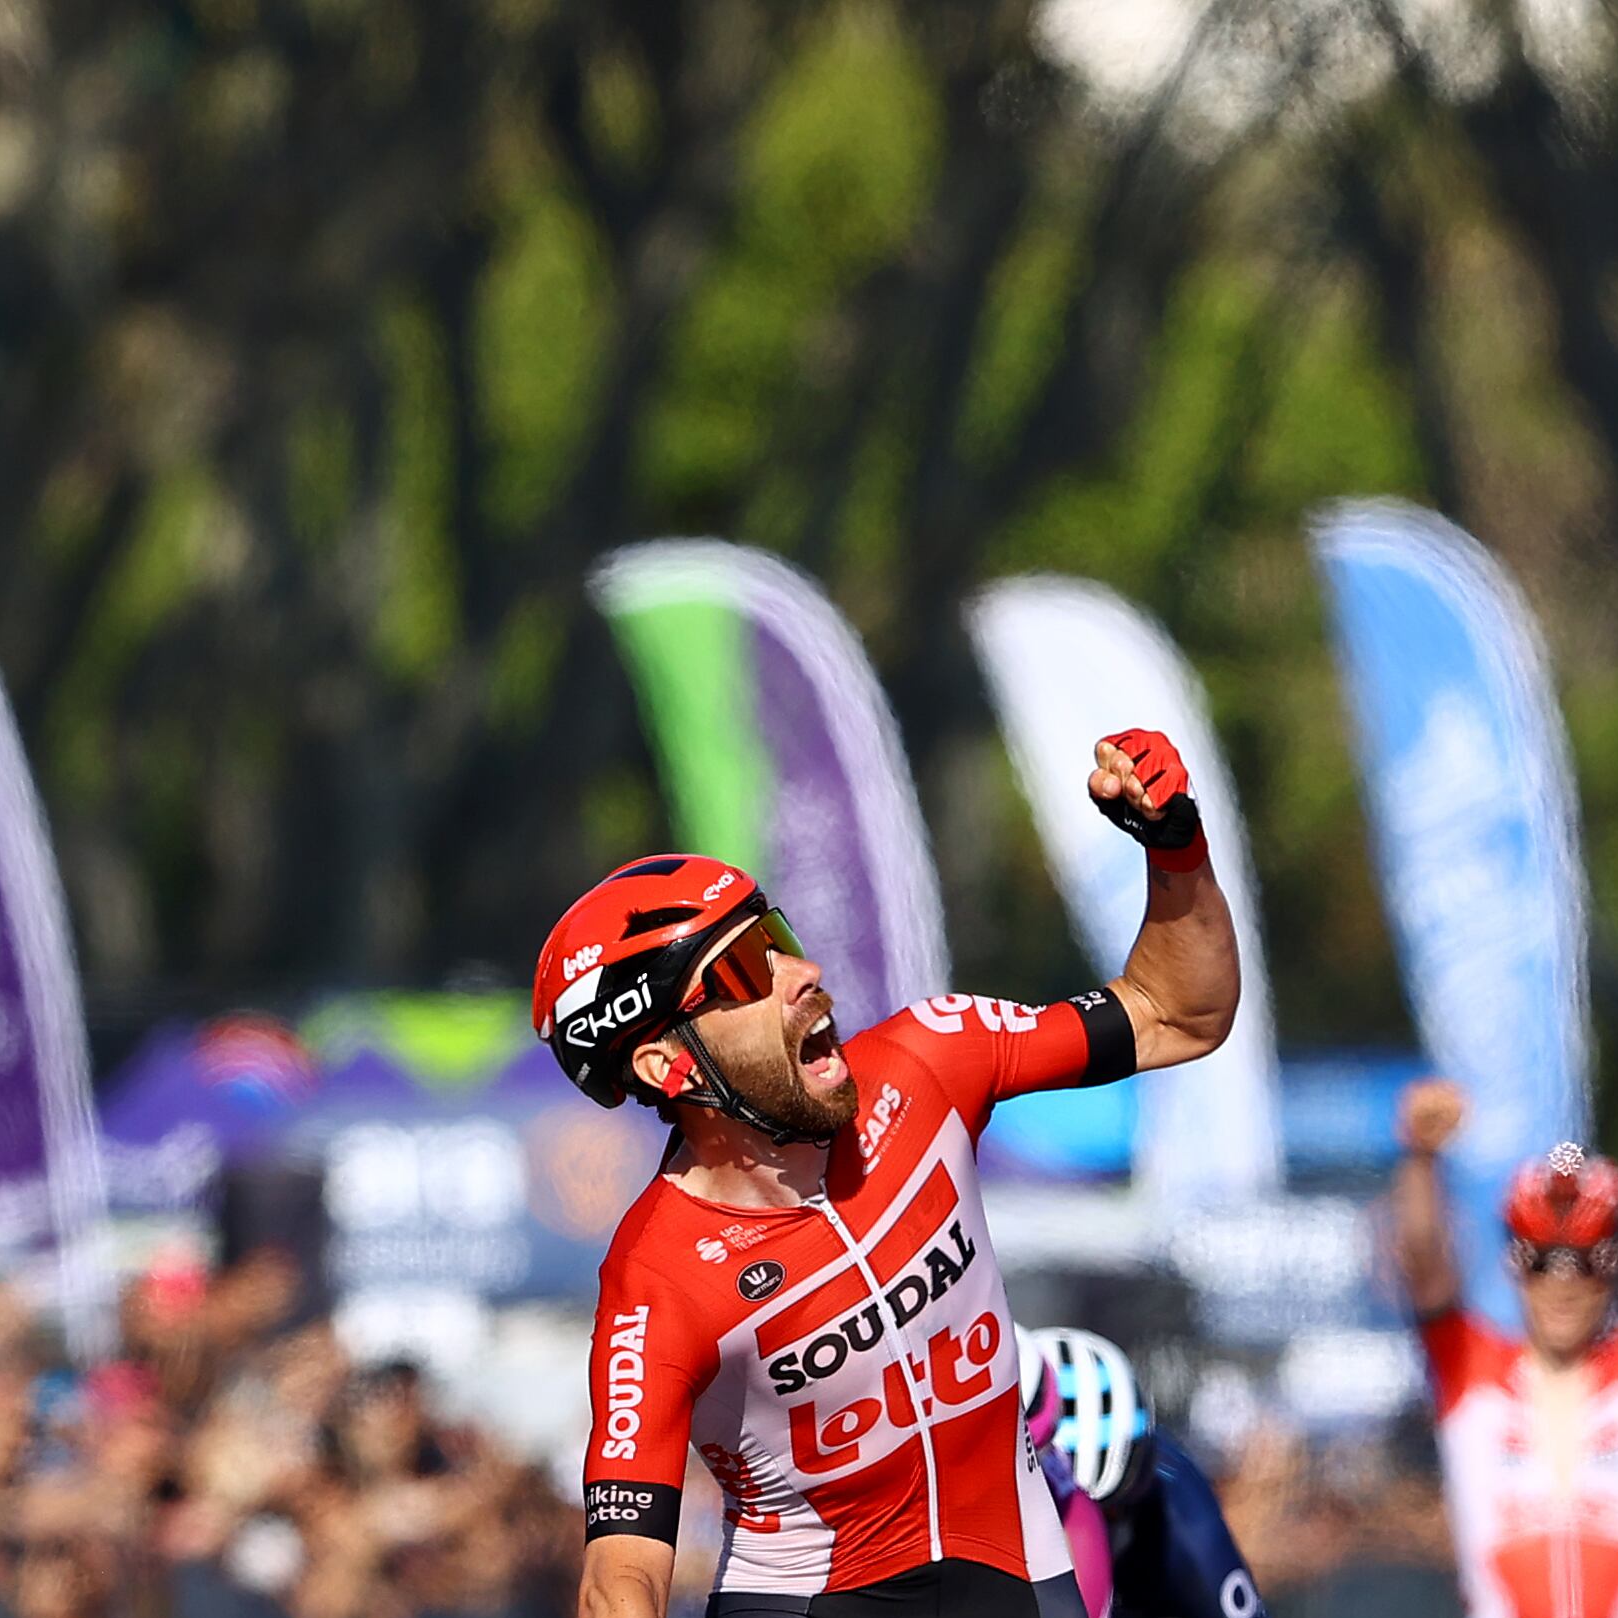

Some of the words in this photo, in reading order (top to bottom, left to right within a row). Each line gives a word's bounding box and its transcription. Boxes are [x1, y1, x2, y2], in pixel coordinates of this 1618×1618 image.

[719, 1223, 744, 1238] UCI
[734, 1233, 768, 1252] TEAM
[768, 1219, 976, 1396] SOUDAL
[601, 1305, 650, 1460] SOUDAL
[588, 1505, 640, 1528] otto
